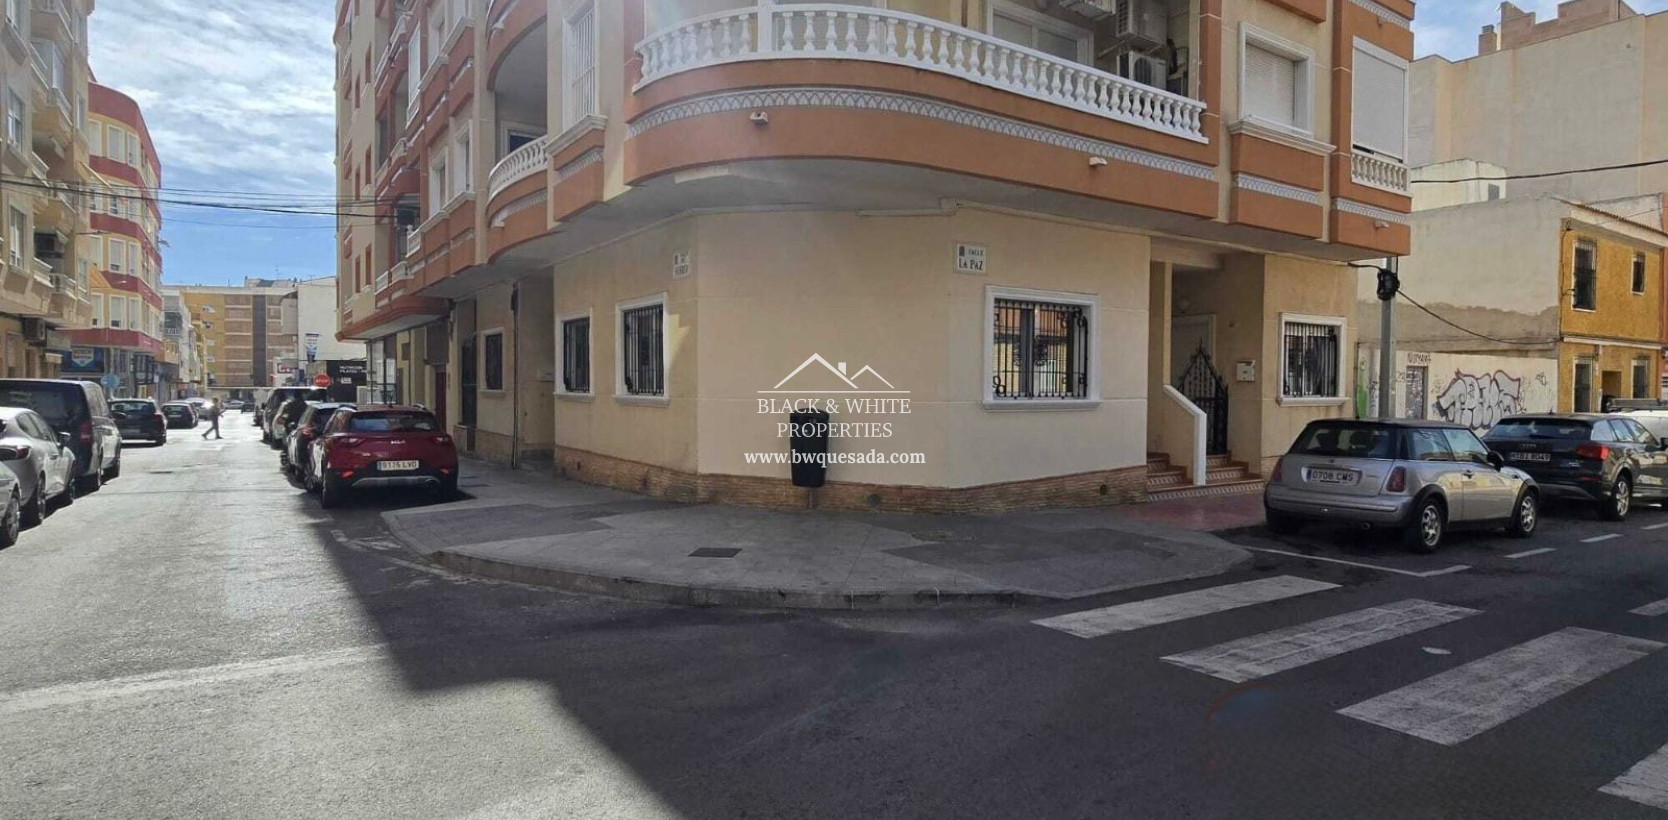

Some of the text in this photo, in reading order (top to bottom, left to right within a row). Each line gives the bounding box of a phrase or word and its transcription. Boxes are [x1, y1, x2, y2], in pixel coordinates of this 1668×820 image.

[958, 257, 983, 270] LA PAZ
[1312, 471, 1334, 480] 0708
